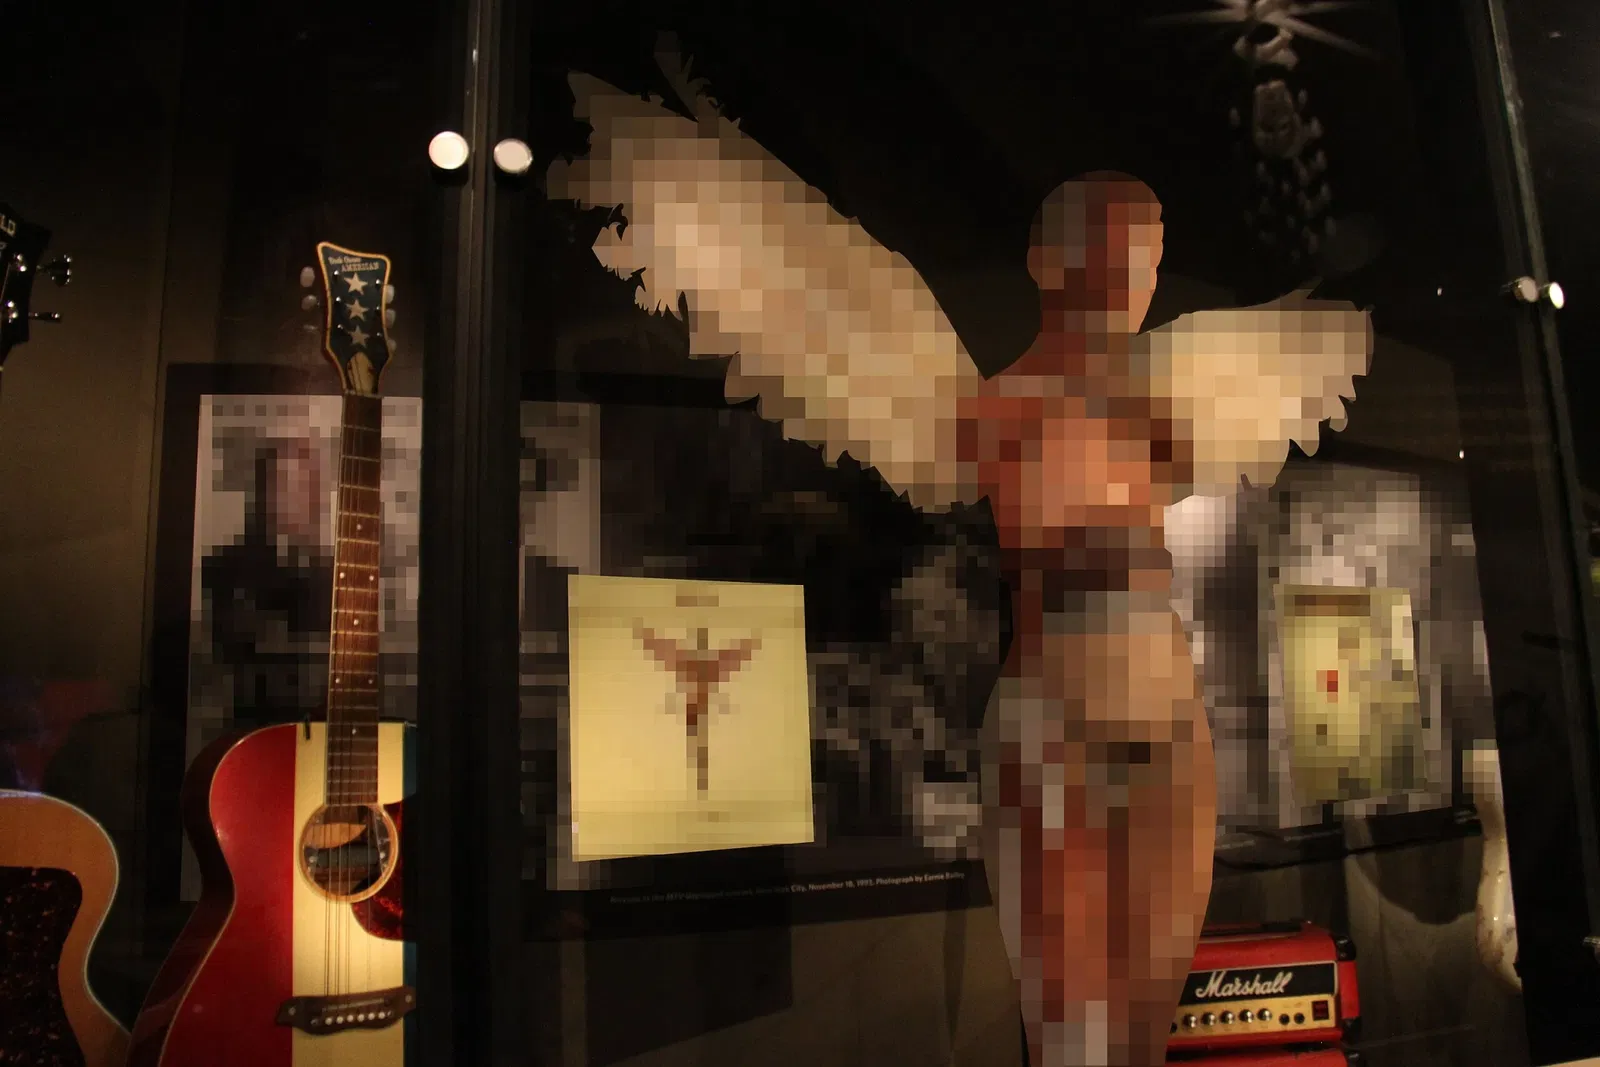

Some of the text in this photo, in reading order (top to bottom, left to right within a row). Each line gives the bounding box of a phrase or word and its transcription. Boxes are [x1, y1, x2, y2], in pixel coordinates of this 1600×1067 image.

[808, 882, 844, 891] November
[875, 875, 913, 886] Photograph
[914, 875, 923, 884] by
[1195, 970, 1293, 998] Marshall
